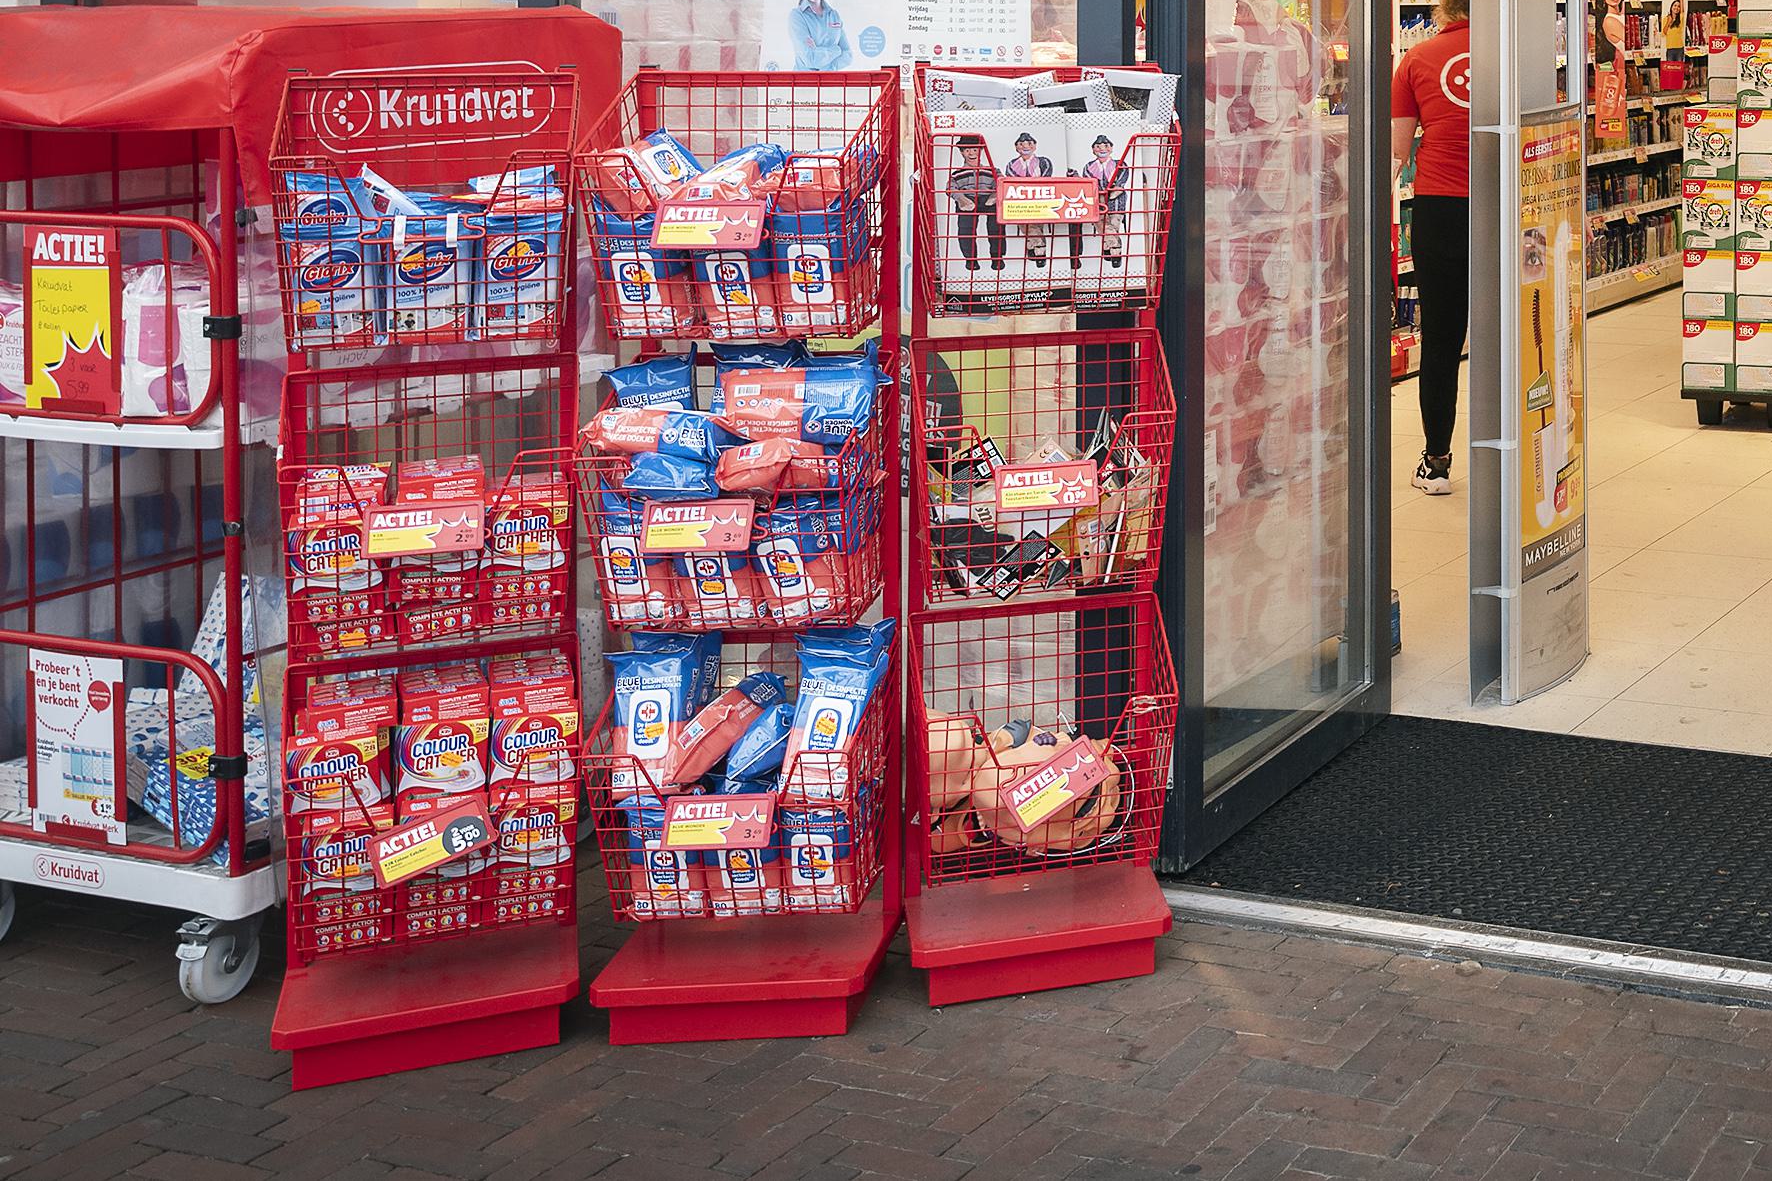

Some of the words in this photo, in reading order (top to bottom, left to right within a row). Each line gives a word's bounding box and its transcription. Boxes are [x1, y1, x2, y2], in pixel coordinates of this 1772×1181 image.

[1740, 44, 1754, 52] 180
[379, 85, 534, 129] Kruidvat
[1687, 114, 1701, 122] 180
[1741, 114, 1755, 122] 180
[1710, 137, 1723, 146] dreft
[1523, 146, 1535, 159] ALS
[1005, 185, 1055, 199] ACTIE!
[1685, 184, 1700, 193] 180
[1740, 185, 1754, 194] 180
[663, 206, 719, 221] ACTIE!
[1708, 207, 1722, 217] dreft
[33, 232, 105, 264] ACTIE!
[304, 262, 354, 282] Glorix
[621, 395, 648, 407] BLUE
[1003, 471, 1054, 487] ACTIE!
[373, 510, 433, 528] ACTIE!
[555, 508, 567, 516] 28
[651, 506, 707, 522] ACTIE!
[494, 515, 548, 537] COLOUR
[300, 534, 360, 554] COLOUR
[1525, 524, 1582, 567] MAYBELLINE
[35, 660, 70, 676] Probeer
[36, 677, 46, 688] en
[48, 678, 57, 691] je
[59, 679, 81, 693] bent
[617, 677, 640, 687] BLUE
[642, 675, 683, 684] DESINFECTIE
[802, 678, 826, 690] BLUE
[827, 684, 868, 696] DESINFECTIE
[39, 694, 79, 708] verkocht
[475, 726, 487, 734] 28
[564, 719, 576, 727] 28
[413, 735, 469, 757] COLOUR
[503, 728, 558, 750] COLOUR
[363, 744, 377, 752] 28
[300, 754, 358, 778] COLOUR
[614, 774, 625, 783] 80
[561, 804, 573, 812] 28
[673, 802, 727, 819] ACTIE!
[500, 813, 556, 832] COLOUR
[378, 821, 437, 858] ACTIE!
[452, 828, 481, 852] 5.00
[50, 861, 99, 884] Kruidvat
